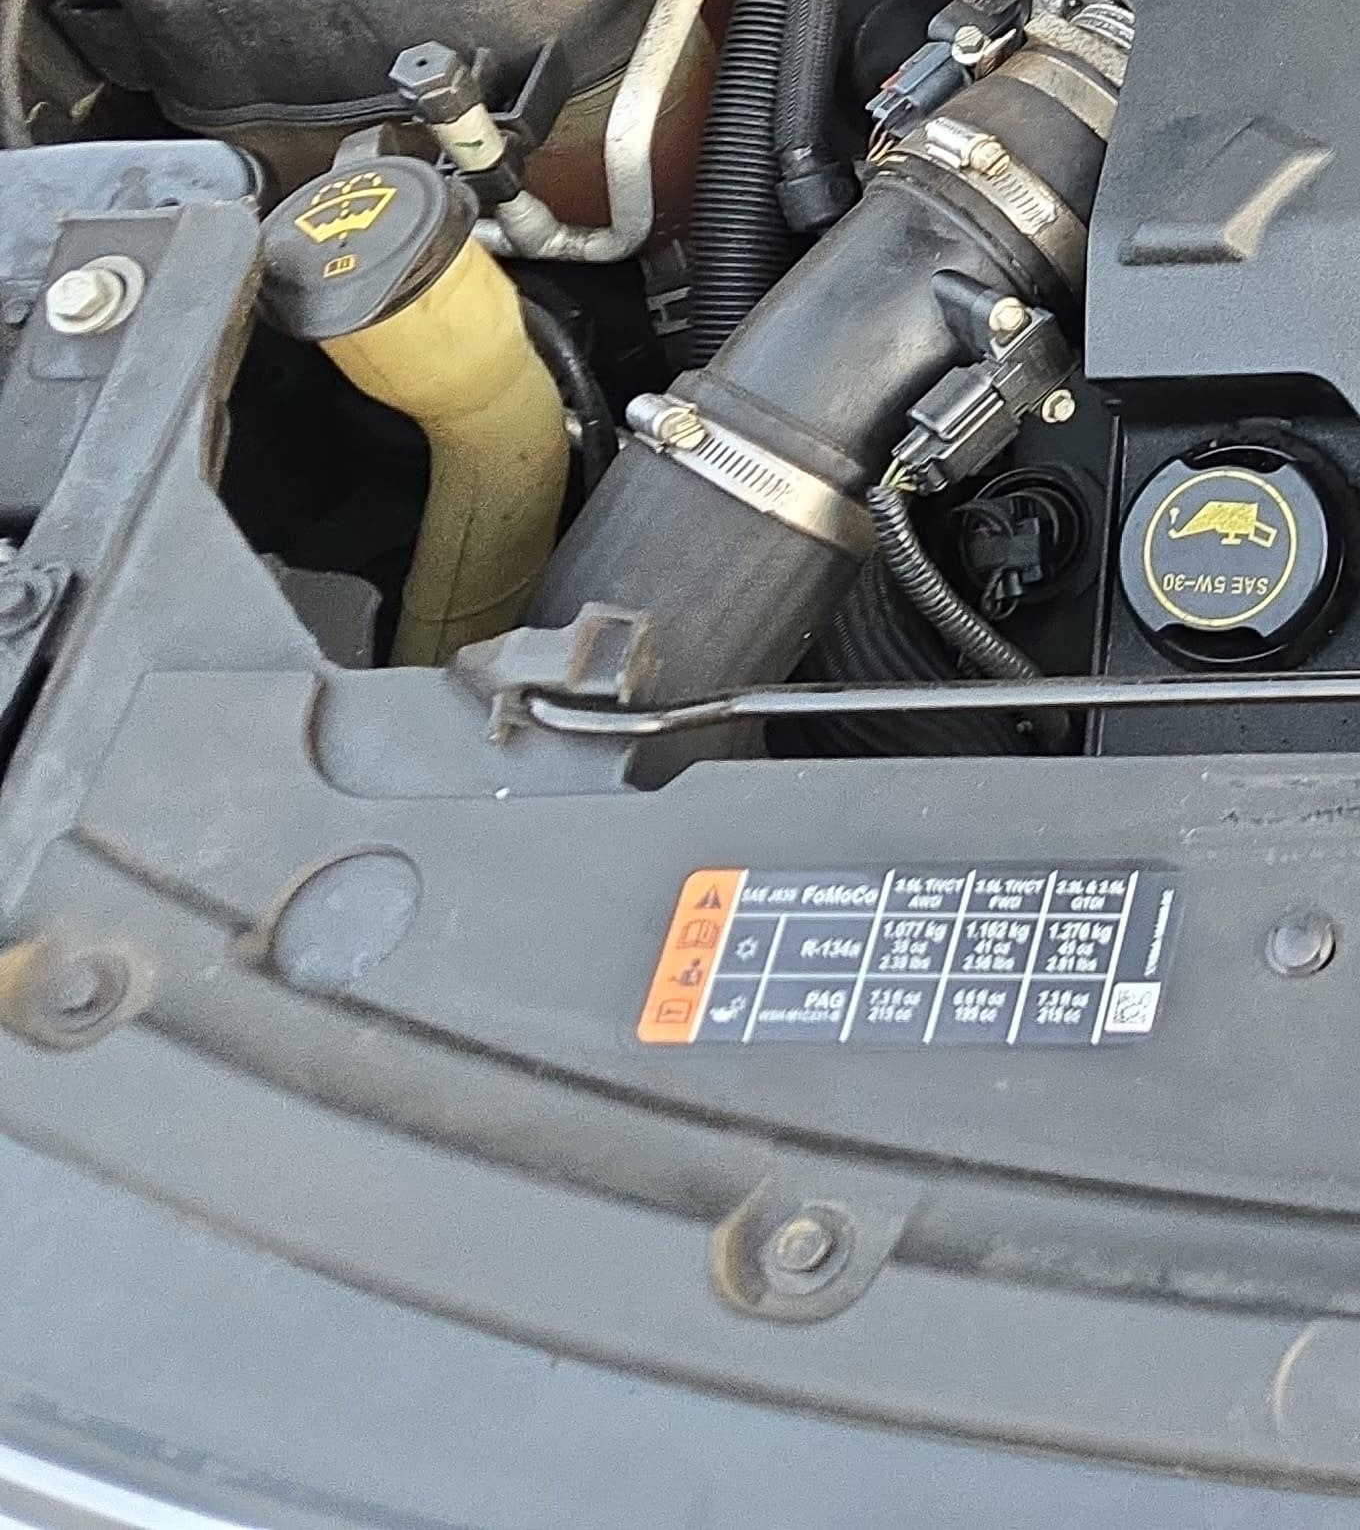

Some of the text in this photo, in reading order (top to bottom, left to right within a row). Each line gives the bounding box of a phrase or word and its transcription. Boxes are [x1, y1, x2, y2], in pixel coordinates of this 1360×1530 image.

[1162, 573, 1269, 595] SAE 5W-30
[801, 883, 879, 906] FoMoCo
[908, 894, 944, 909] AWD
[988, 895, 1023, 910] FWD
[883, 921, 948, 943] 1.077 kg
[1008, 921, 1031, 944] kg
[1092, 922, 1114, 944] kg
[800, 937, 862, 959] R-134a
[911, 941, 929, 954] oz
[973, 940, 1013, 955] 41 oz
[1077, 942, 1096, 956] oz
[804, 988, 847, 1009] PAG
